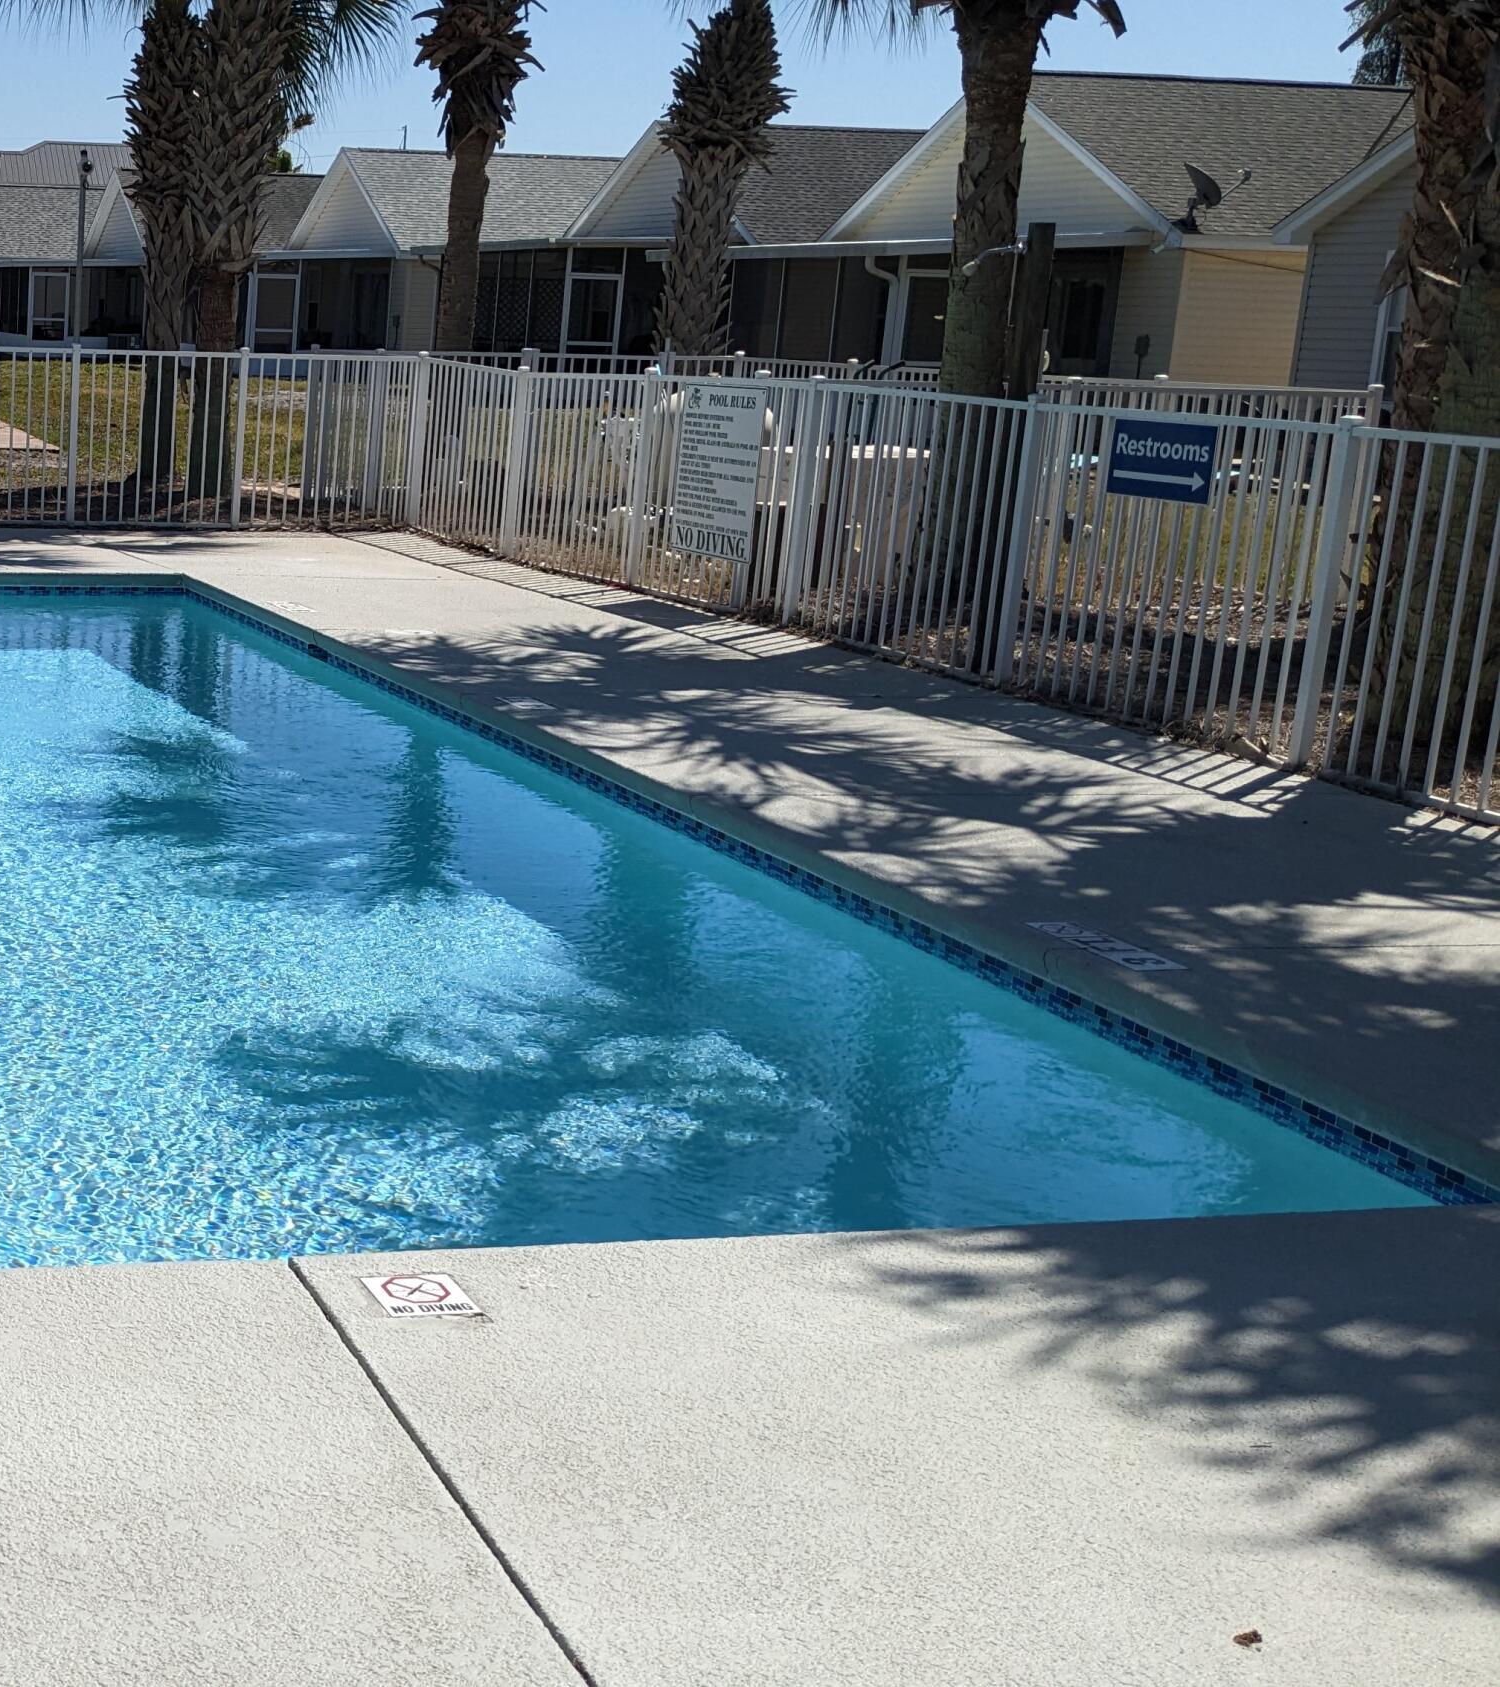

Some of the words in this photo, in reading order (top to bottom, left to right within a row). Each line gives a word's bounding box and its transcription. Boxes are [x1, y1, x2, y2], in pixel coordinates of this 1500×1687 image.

[709, 393, 729, 407] POOL
[730, 395, 757, 410] RULES
[1115, 432, 1210, 463] Restrooms
[675, 525, 693, 548] NO
[695, 530, 746, 559] DIVING
[390, 1305, 415, 1315] NO
[419, 1302, 474, 1313] DIVING
